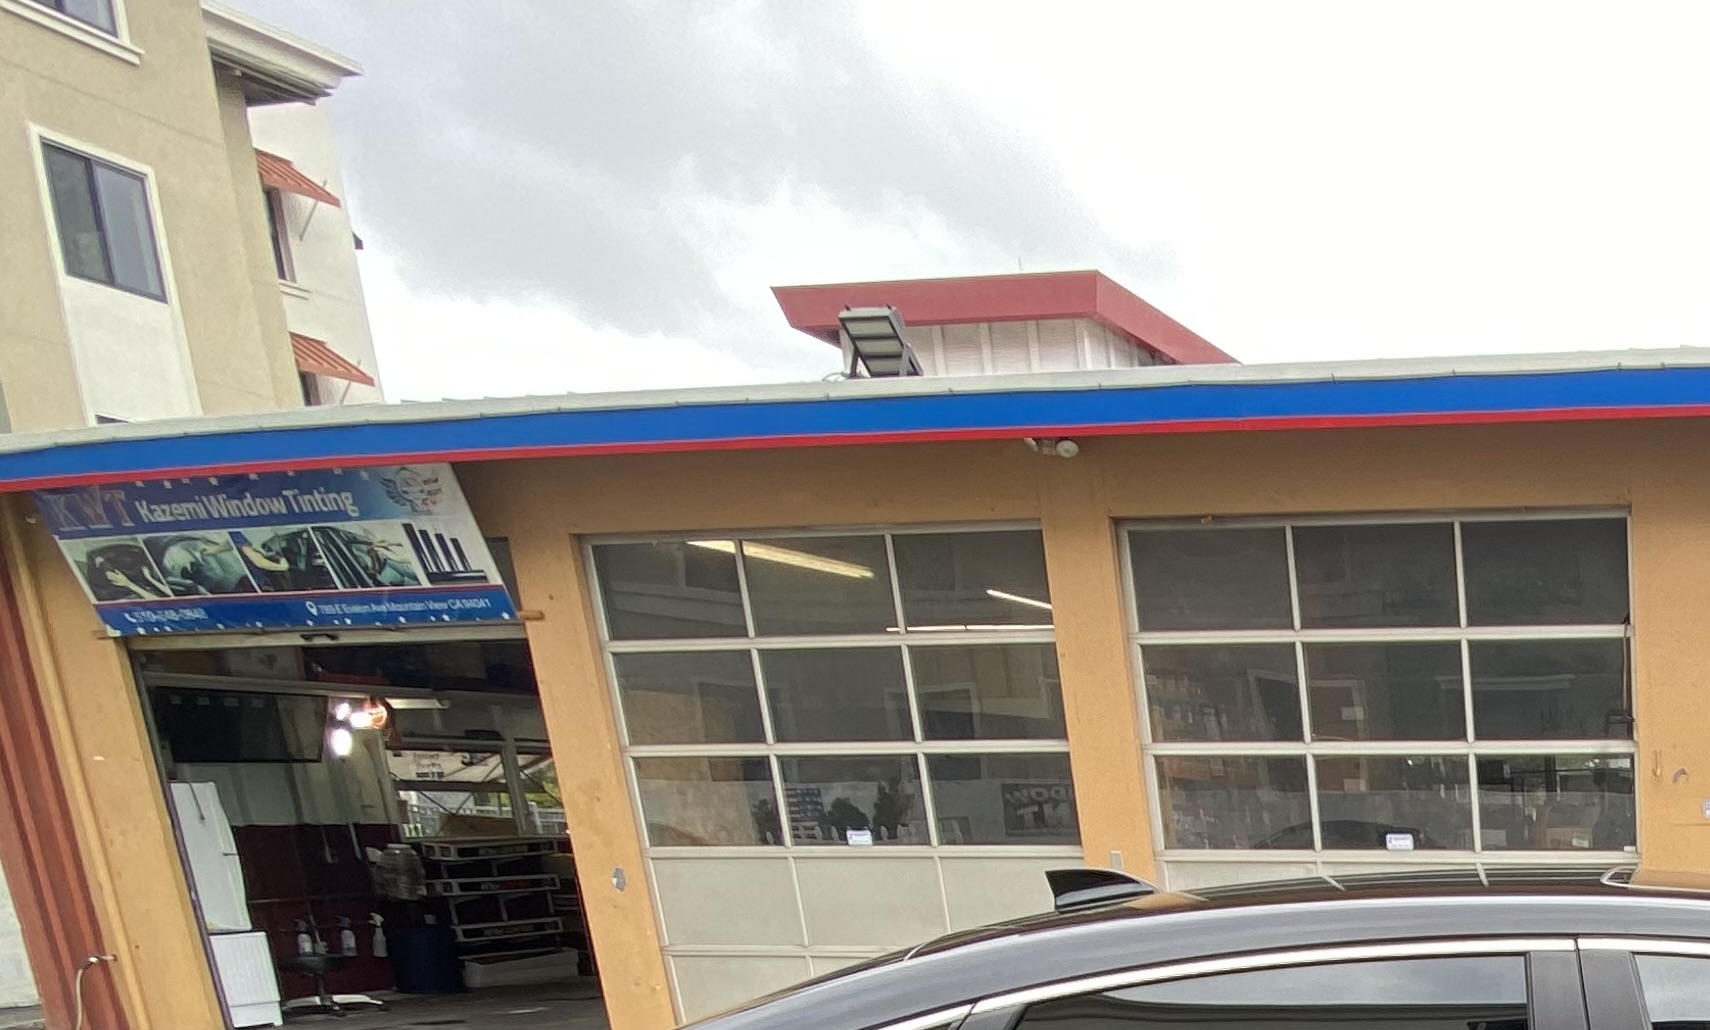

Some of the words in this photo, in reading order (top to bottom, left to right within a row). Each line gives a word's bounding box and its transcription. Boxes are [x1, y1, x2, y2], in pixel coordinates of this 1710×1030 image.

[135, 495, 210, 523] Kazemi
[200, 491, 289, 519] Window
[280, 486, 361, 518] Tinting
[447, 598, 465, 610] CA
